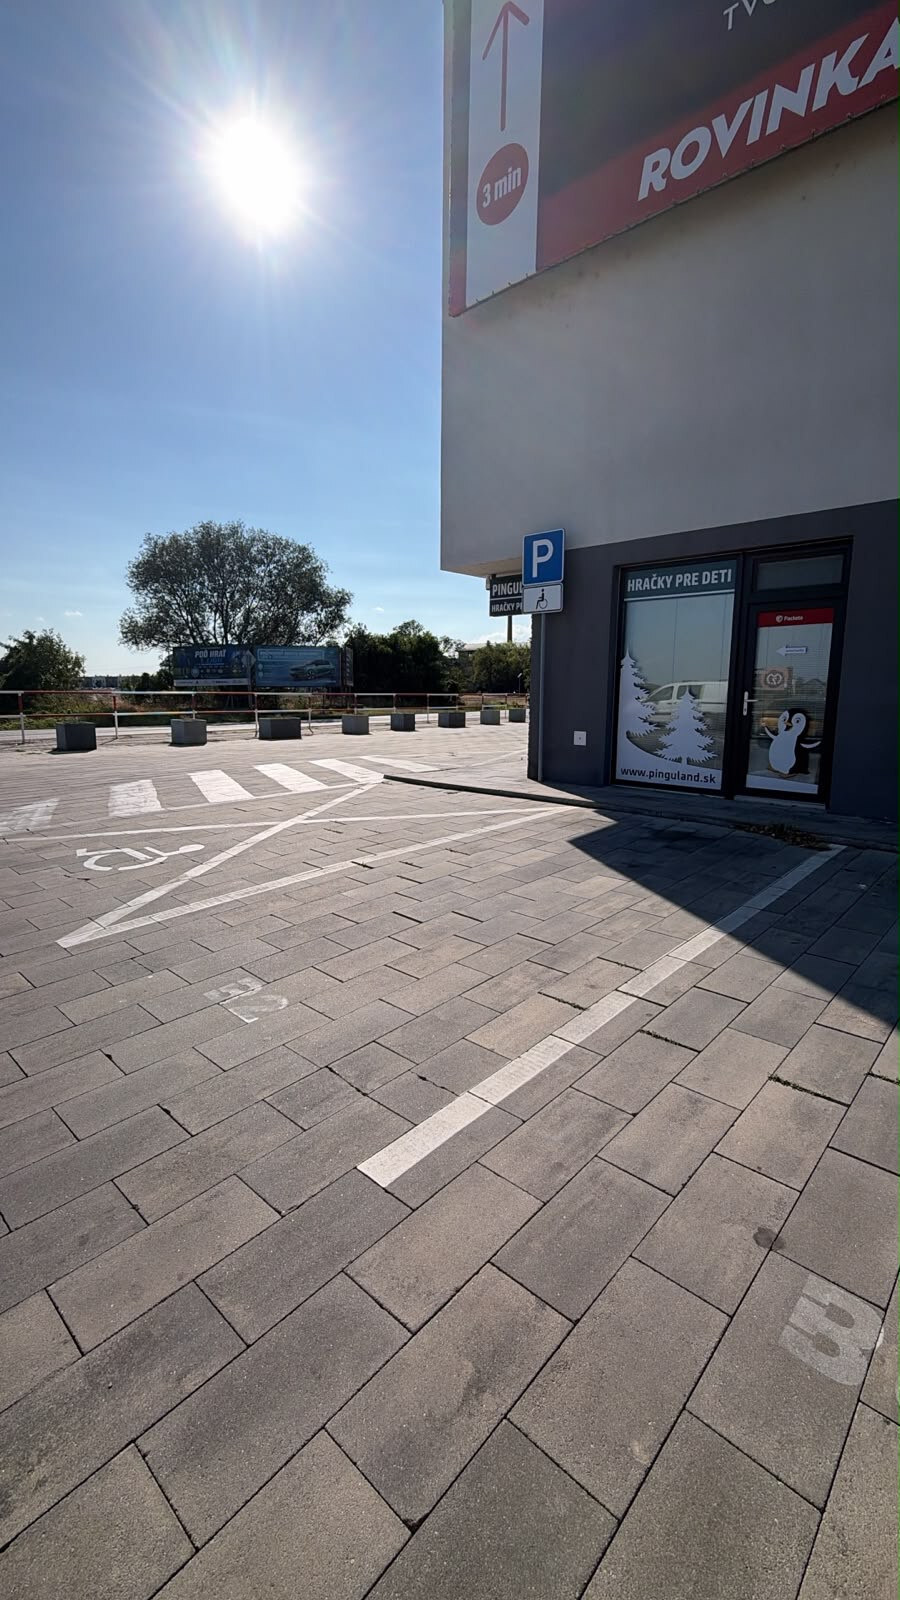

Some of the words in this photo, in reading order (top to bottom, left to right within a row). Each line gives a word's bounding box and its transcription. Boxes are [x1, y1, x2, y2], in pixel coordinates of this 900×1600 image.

[723, 0, 776, 30] TV
[482, 182, 492, 208] 3
[494, 166, 522, 201] min
[532, 538, 554, 578] P
[627, 573, 673, 592] HRAČKY
[675, 571, 699, 588] PRE
[702, 568, 732, 585] DETI
[491, 602, 515, 612] HRAČKY
[620, 767, 717, 784] www.pinguland.sk
